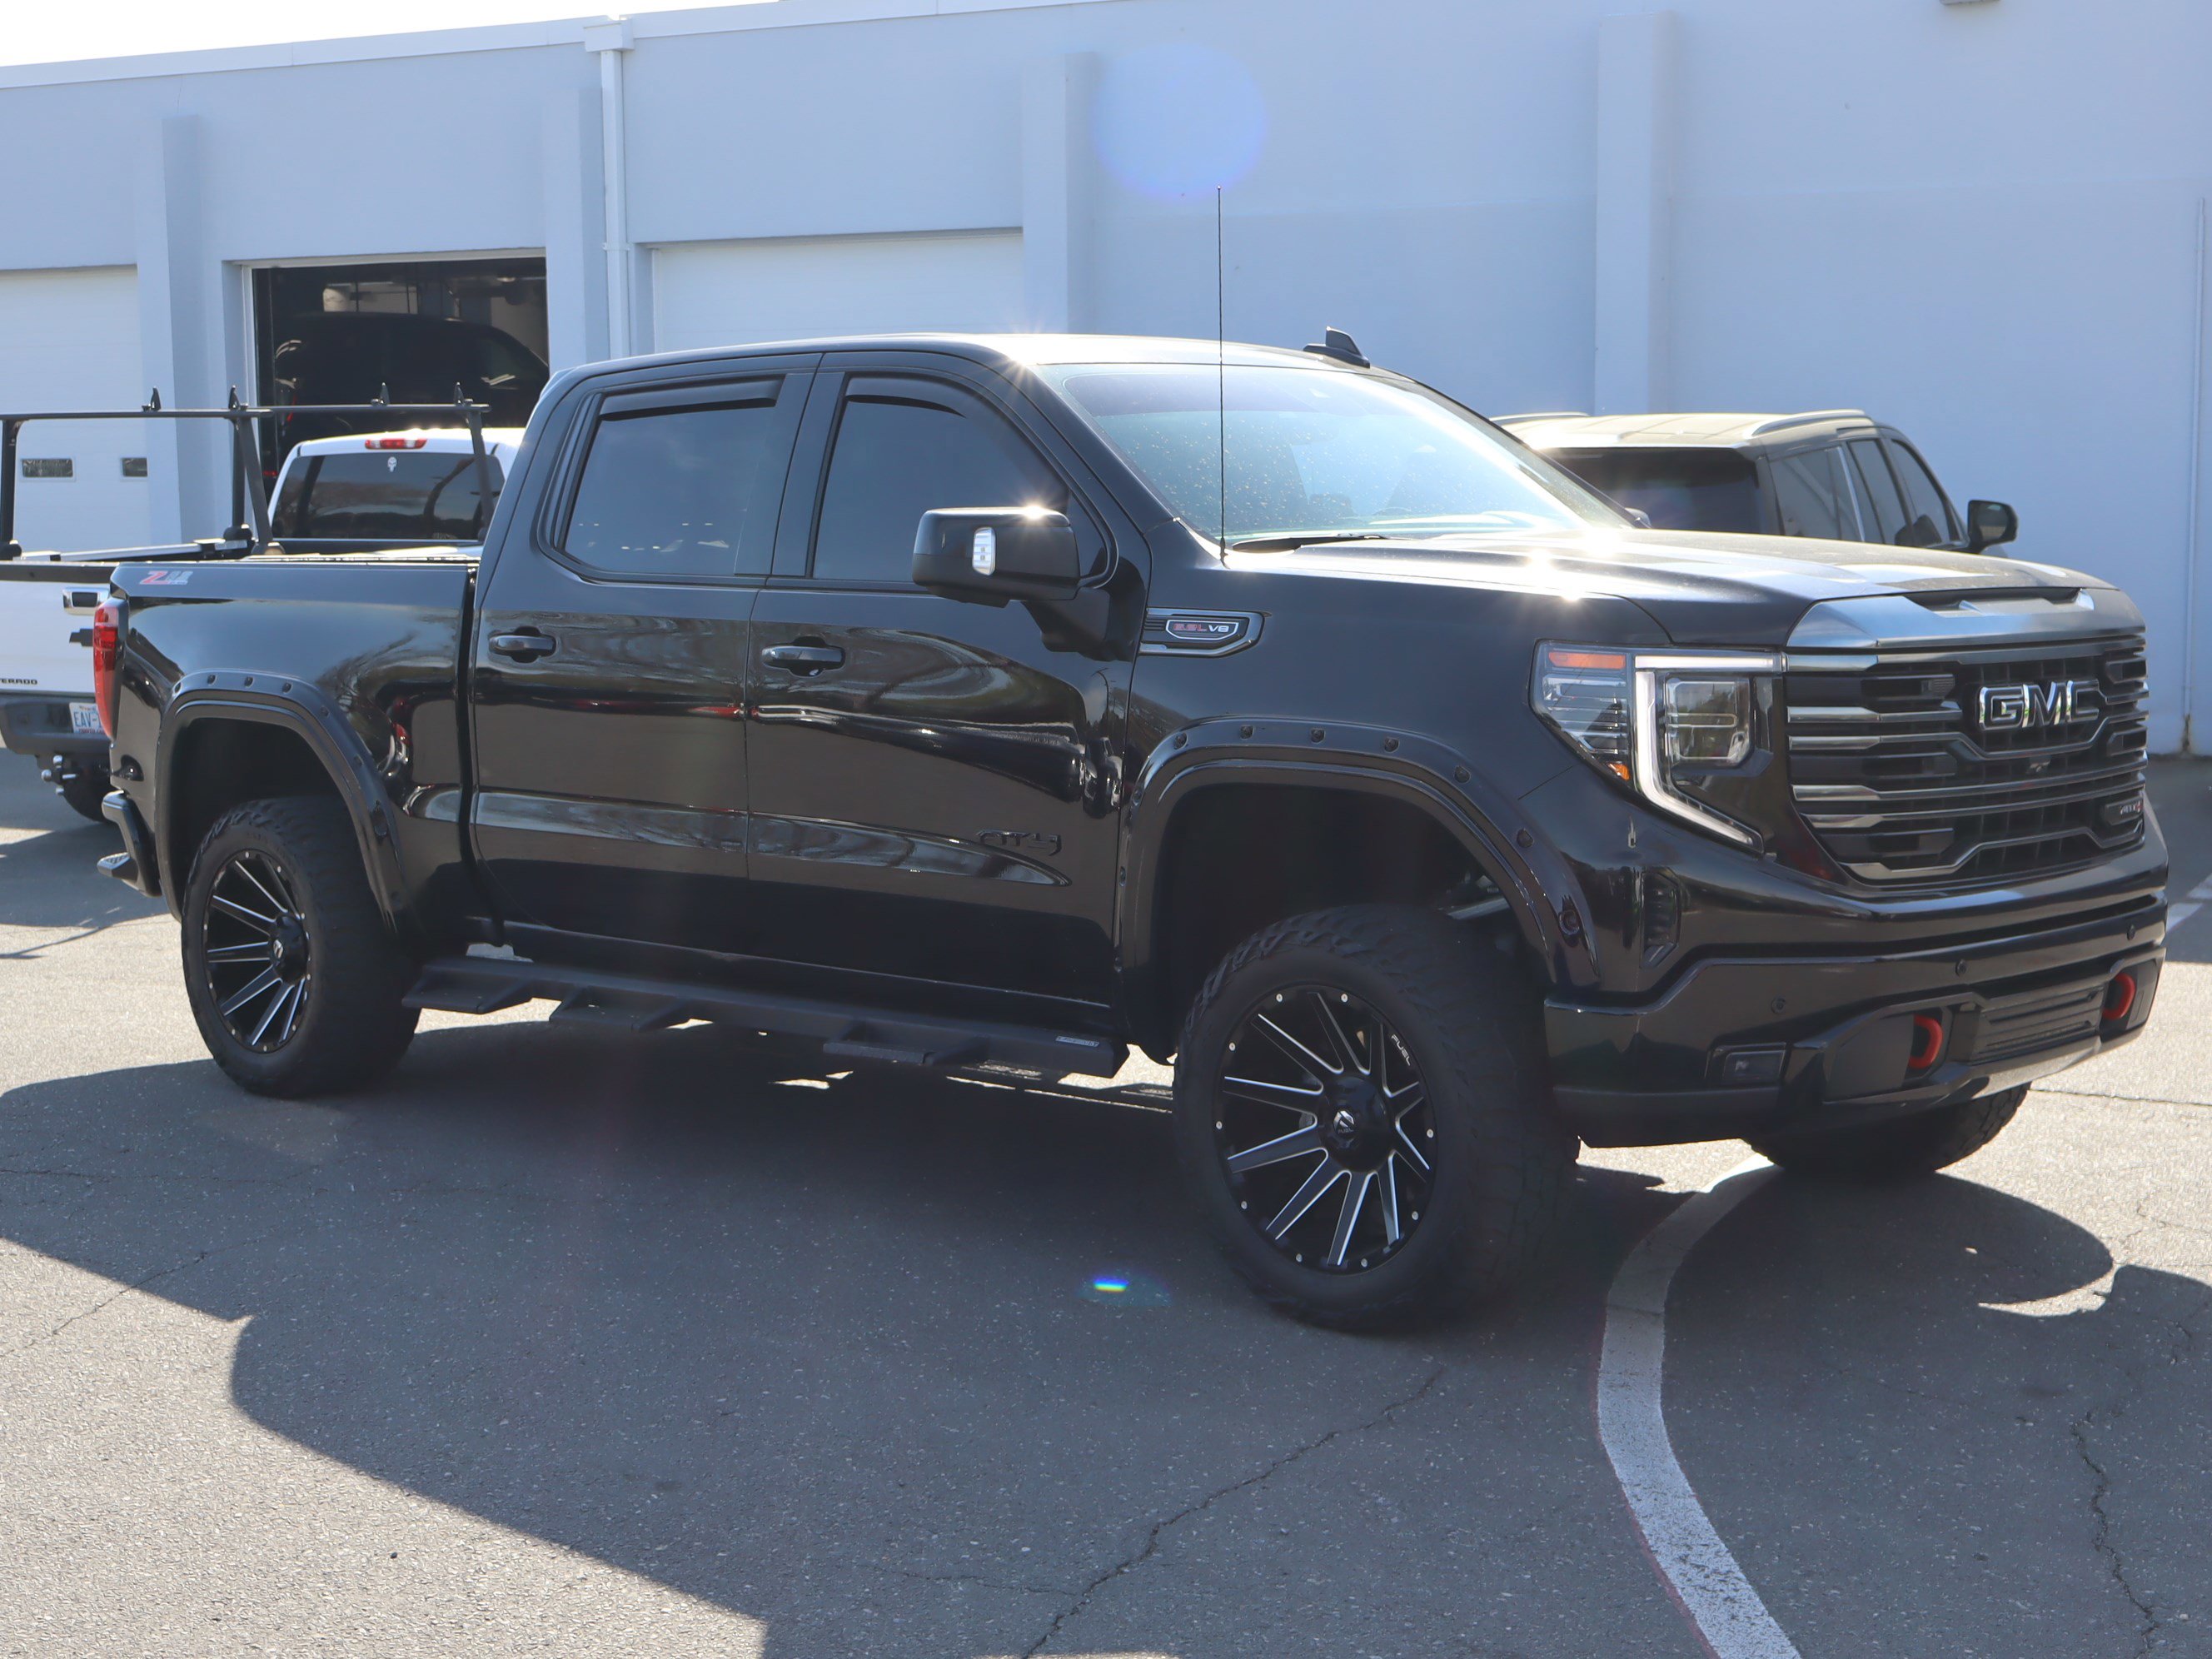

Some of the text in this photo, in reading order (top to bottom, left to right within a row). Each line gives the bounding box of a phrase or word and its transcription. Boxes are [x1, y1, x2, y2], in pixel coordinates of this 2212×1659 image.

[1208, 625, 1230, 633] V8
[1979, 680, 2100, 731] GMC
[1391, 1034, 1411, 1066] FUEL
